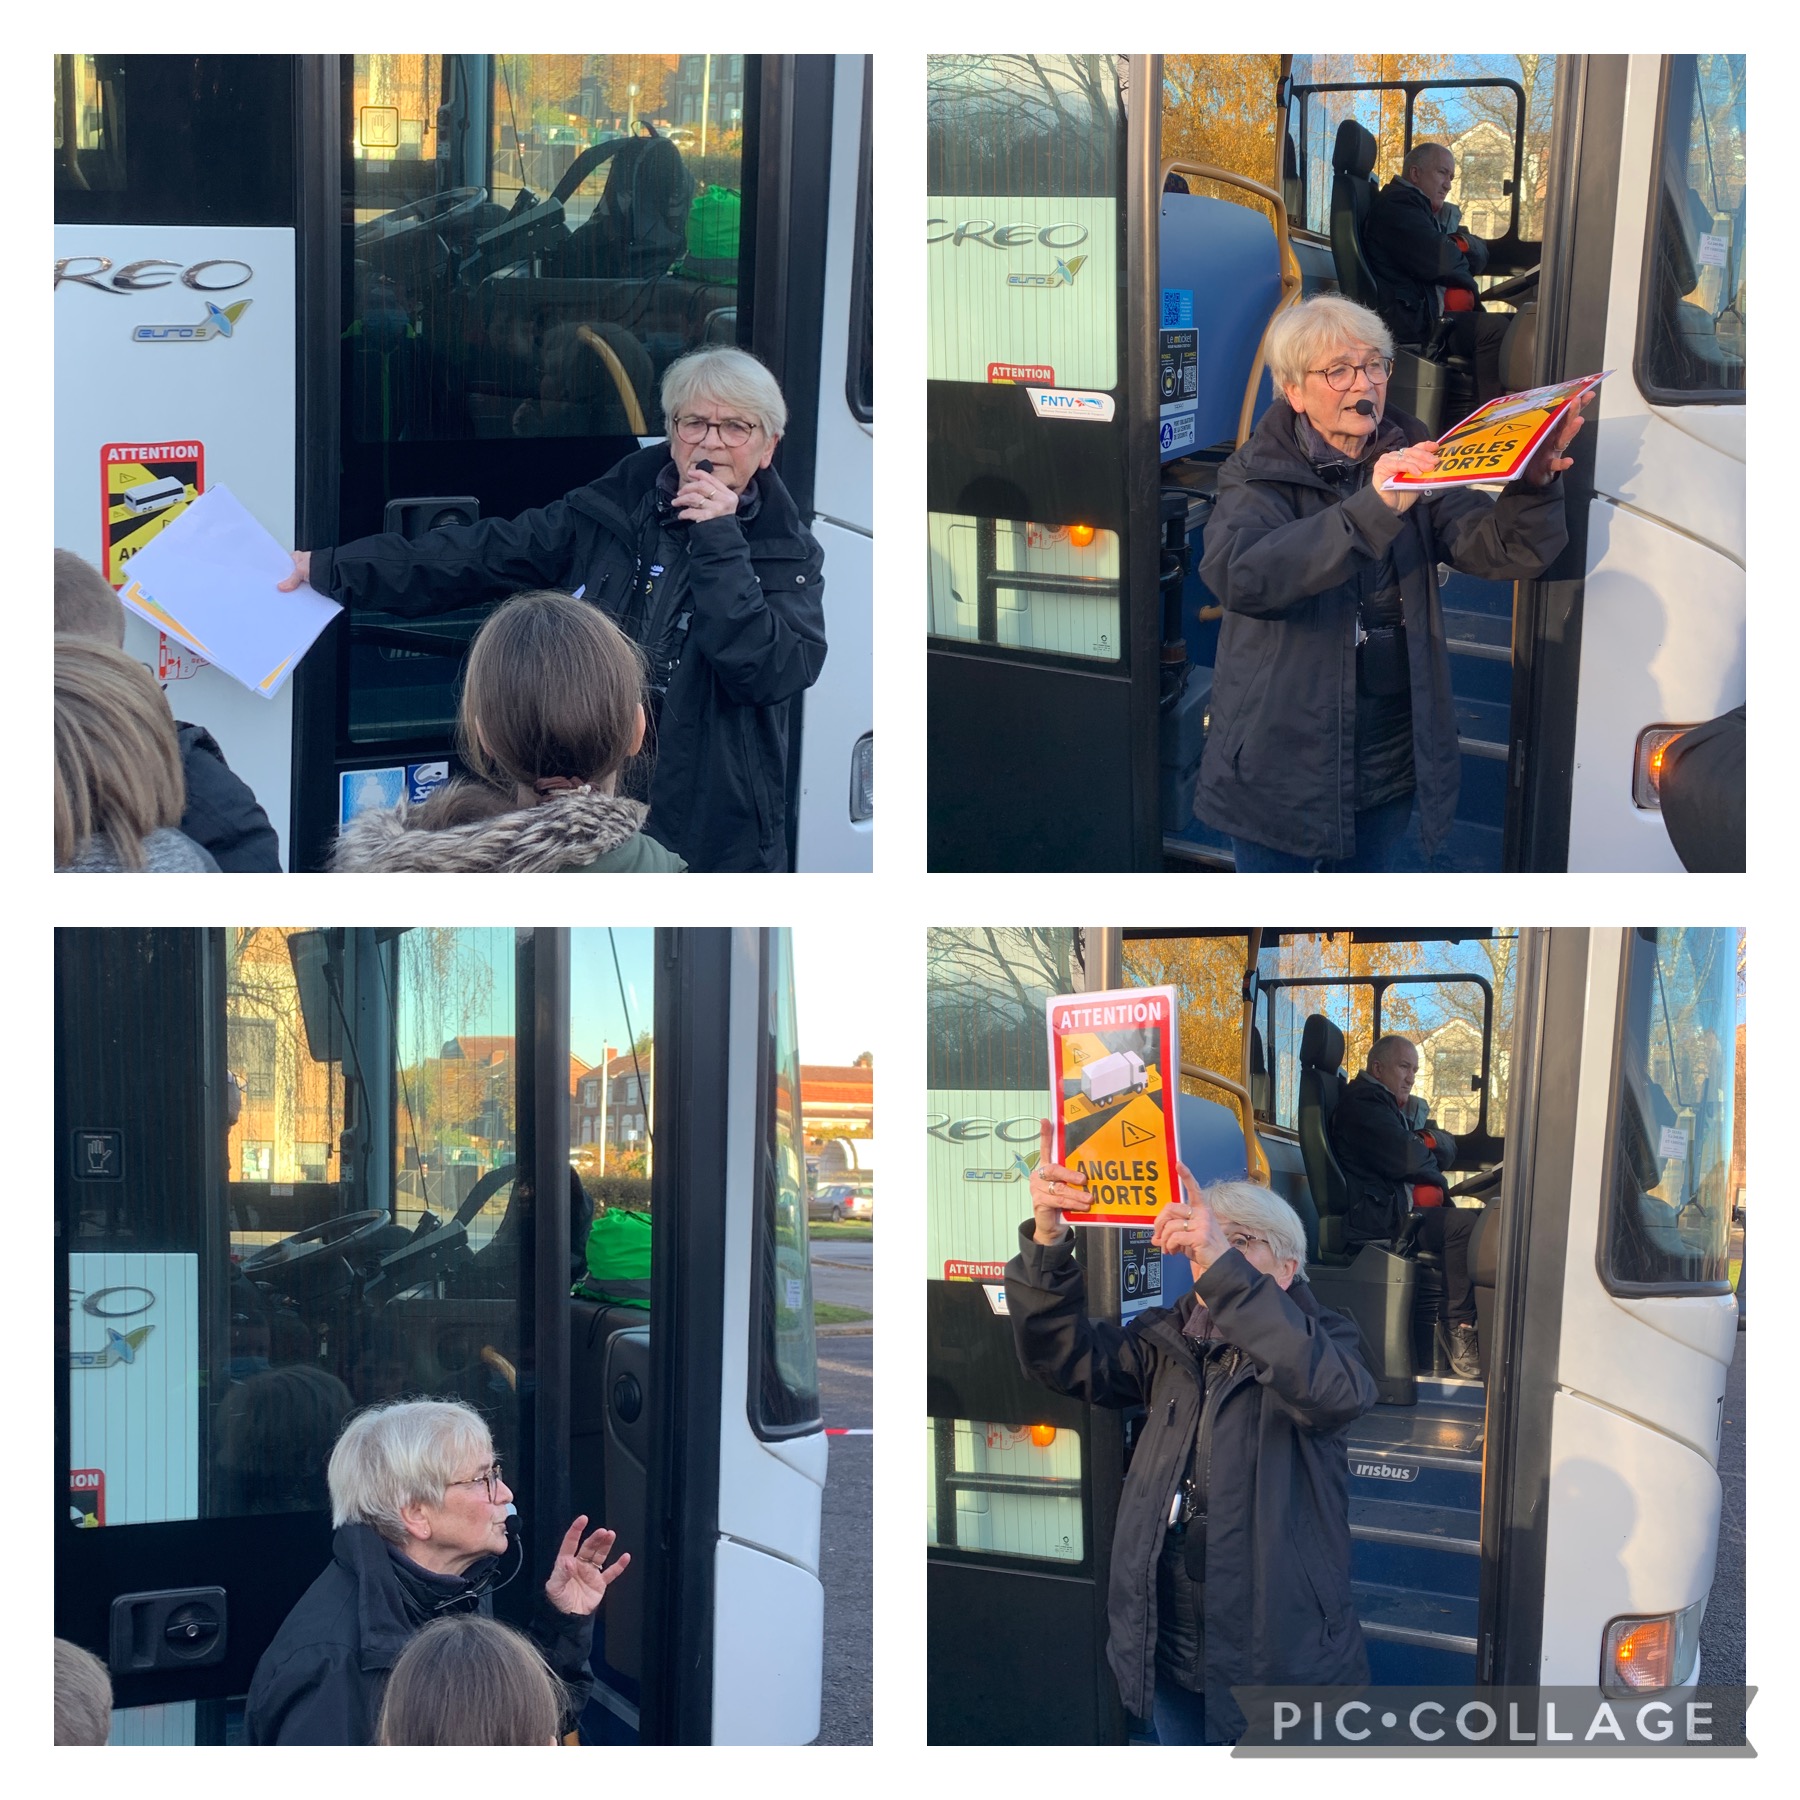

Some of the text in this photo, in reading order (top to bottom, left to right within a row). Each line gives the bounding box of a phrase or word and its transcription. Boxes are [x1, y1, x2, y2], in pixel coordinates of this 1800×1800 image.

[992, 366, 1051, 379] ATTENTION
[1040, 395, 1075, 408] FNTV
[107, 445, 199, 461] ATTENTION
[1433, 440, 1518, 457] ANGLES
[1061, 1002, 1161, 1029] ATTENTION
[1076, 1160, 1159, 1181] ANGLES
[1356, 1464, 1410, 1479] irisbus
